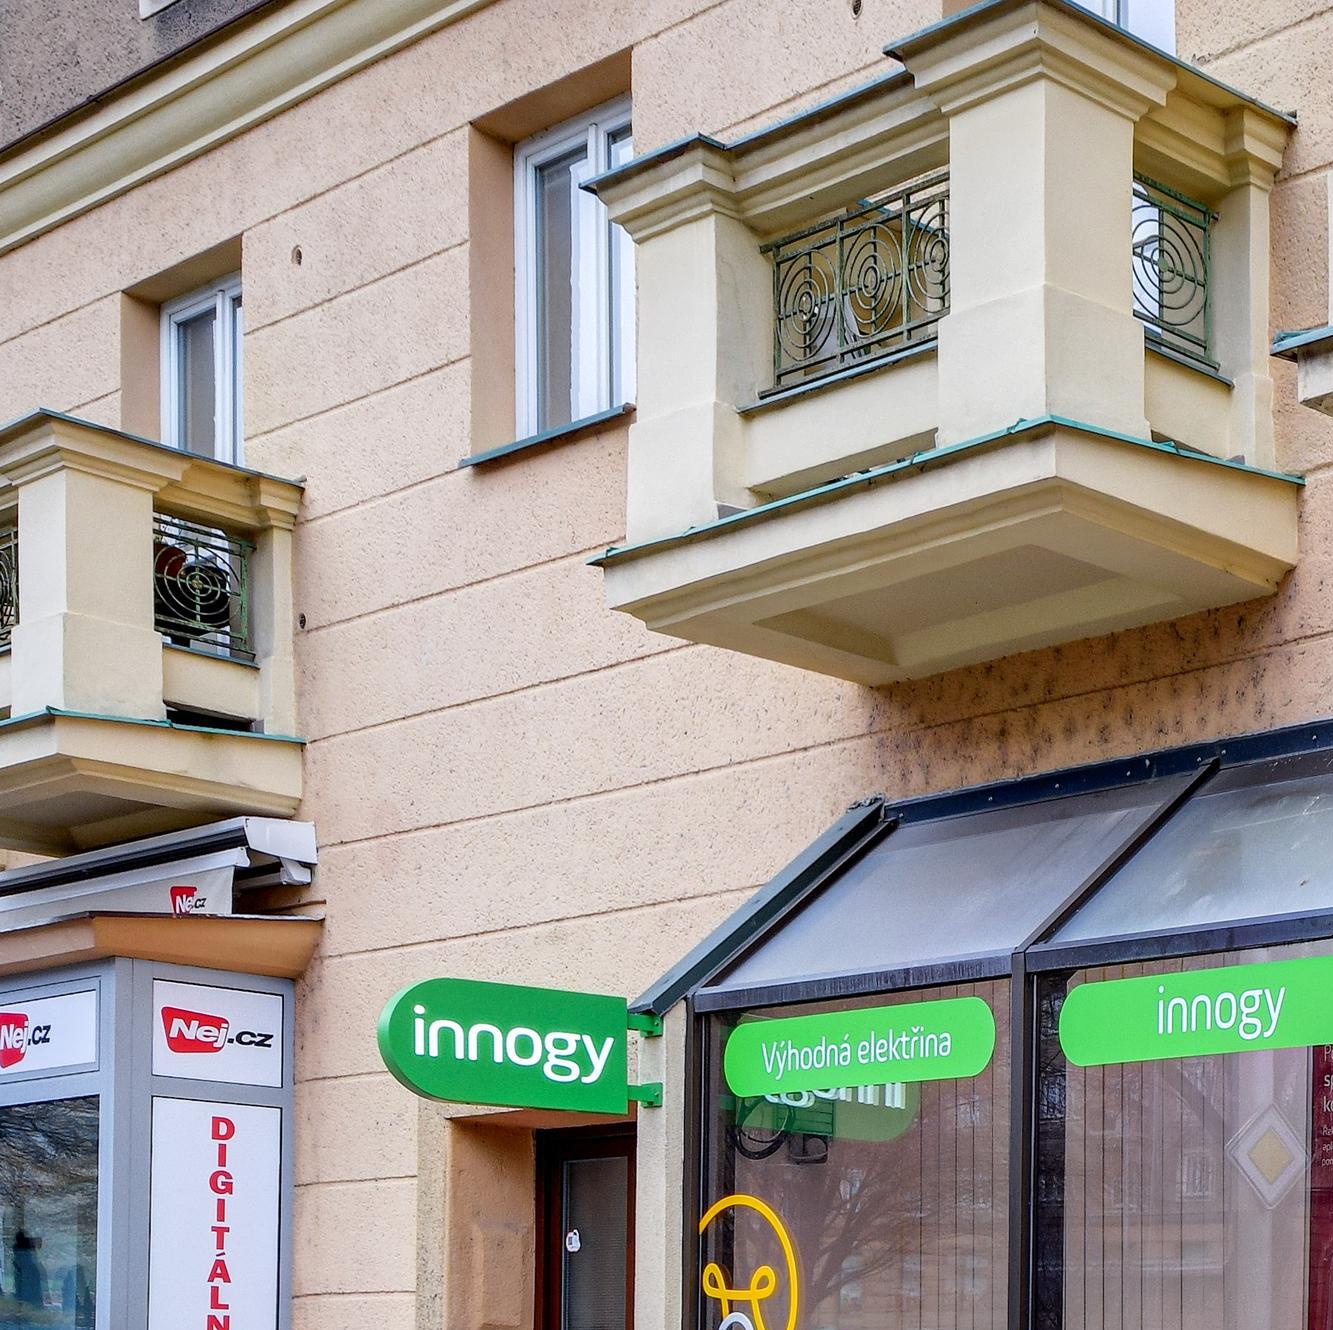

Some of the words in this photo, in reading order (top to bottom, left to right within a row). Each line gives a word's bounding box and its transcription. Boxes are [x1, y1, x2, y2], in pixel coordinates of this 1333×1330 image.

[168, 1017, 274, 1049] Nej.cz
[1157, 985, 1286, 1040] innogy
[413, 1004, 615, 1084] innogy
[761, 1034, 850, 1081] Výhodná
[857, 1026, 952, 1064] elektřina
